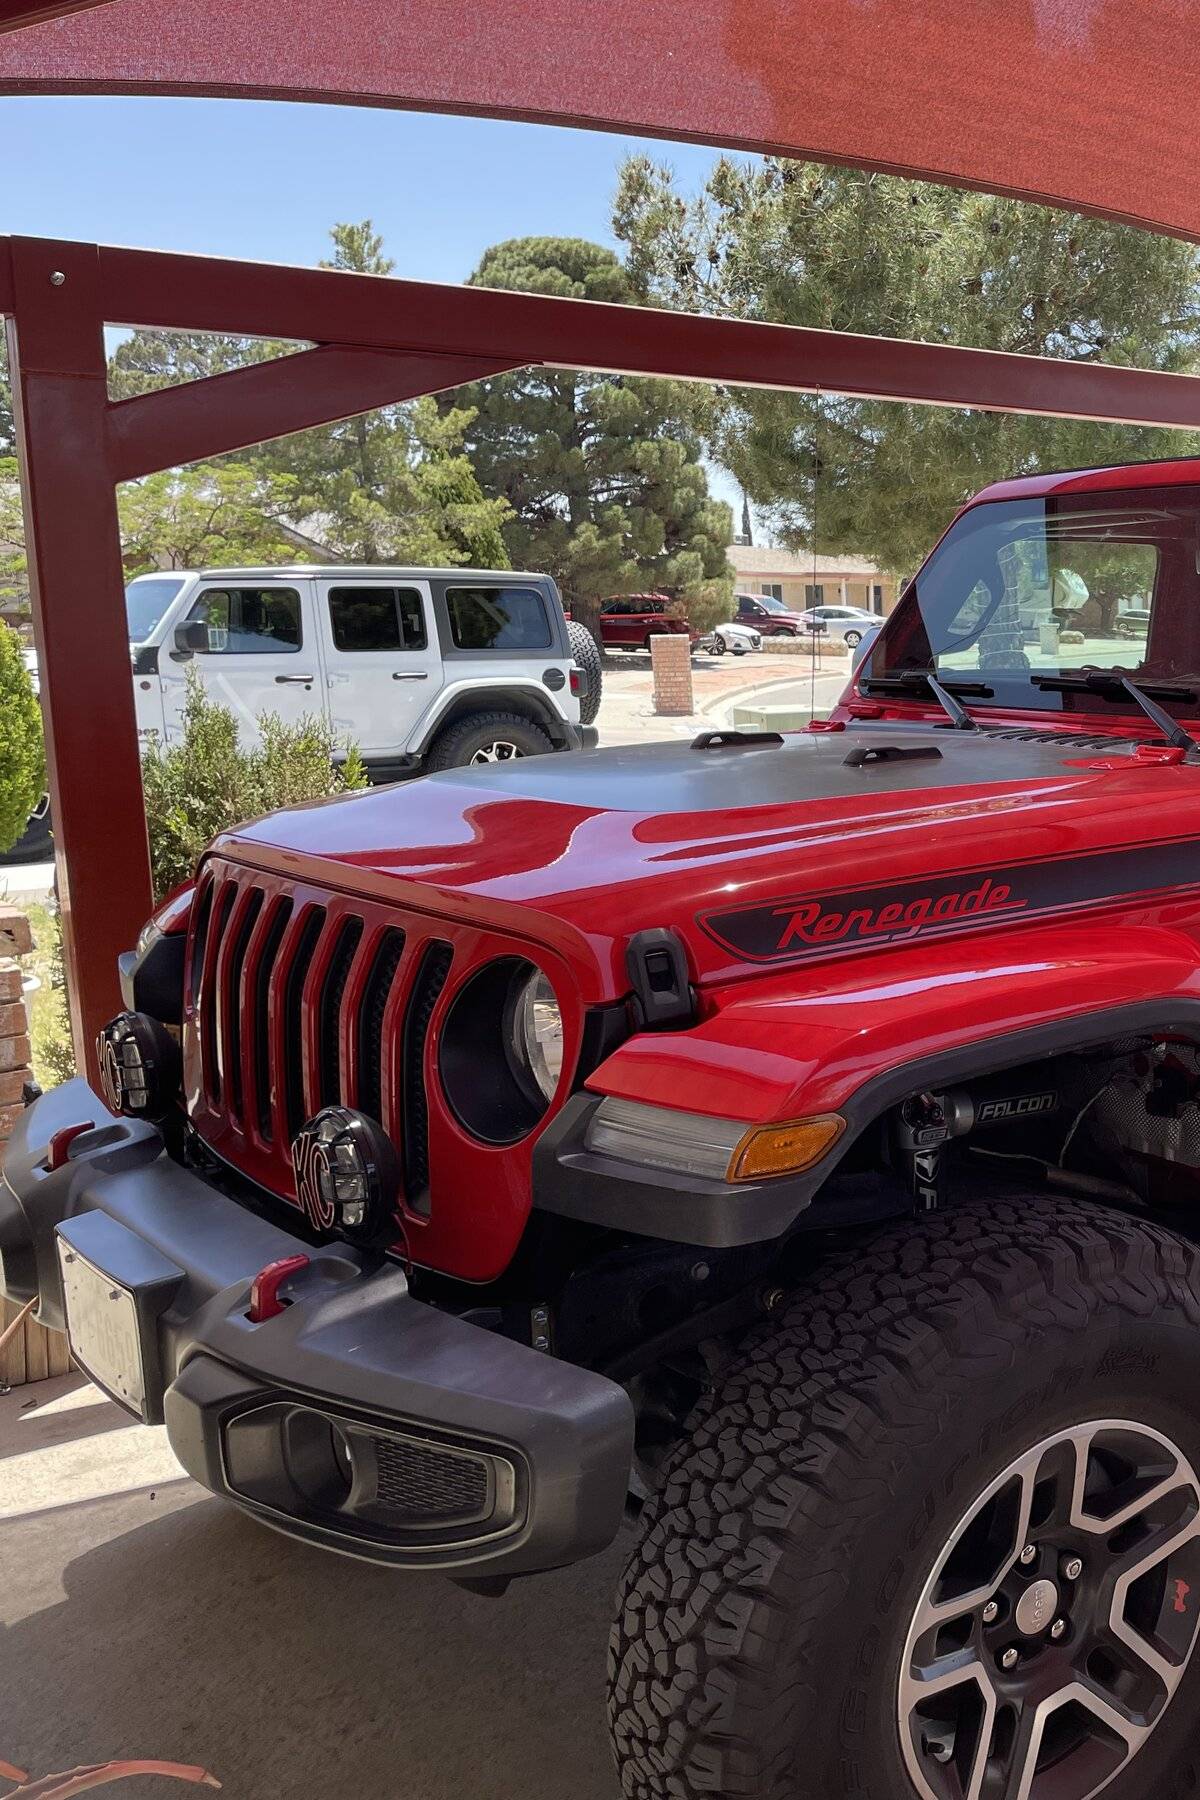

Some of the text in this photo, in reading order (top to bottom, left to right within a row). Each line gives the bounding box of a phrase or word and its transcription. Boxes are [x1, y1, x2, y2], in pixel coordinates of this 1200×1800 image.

[772, 879, 1026, 949] Renegade
[981, 1095, 1053, 1120] FALCON
[292, 1131, 334, 1231] KC
